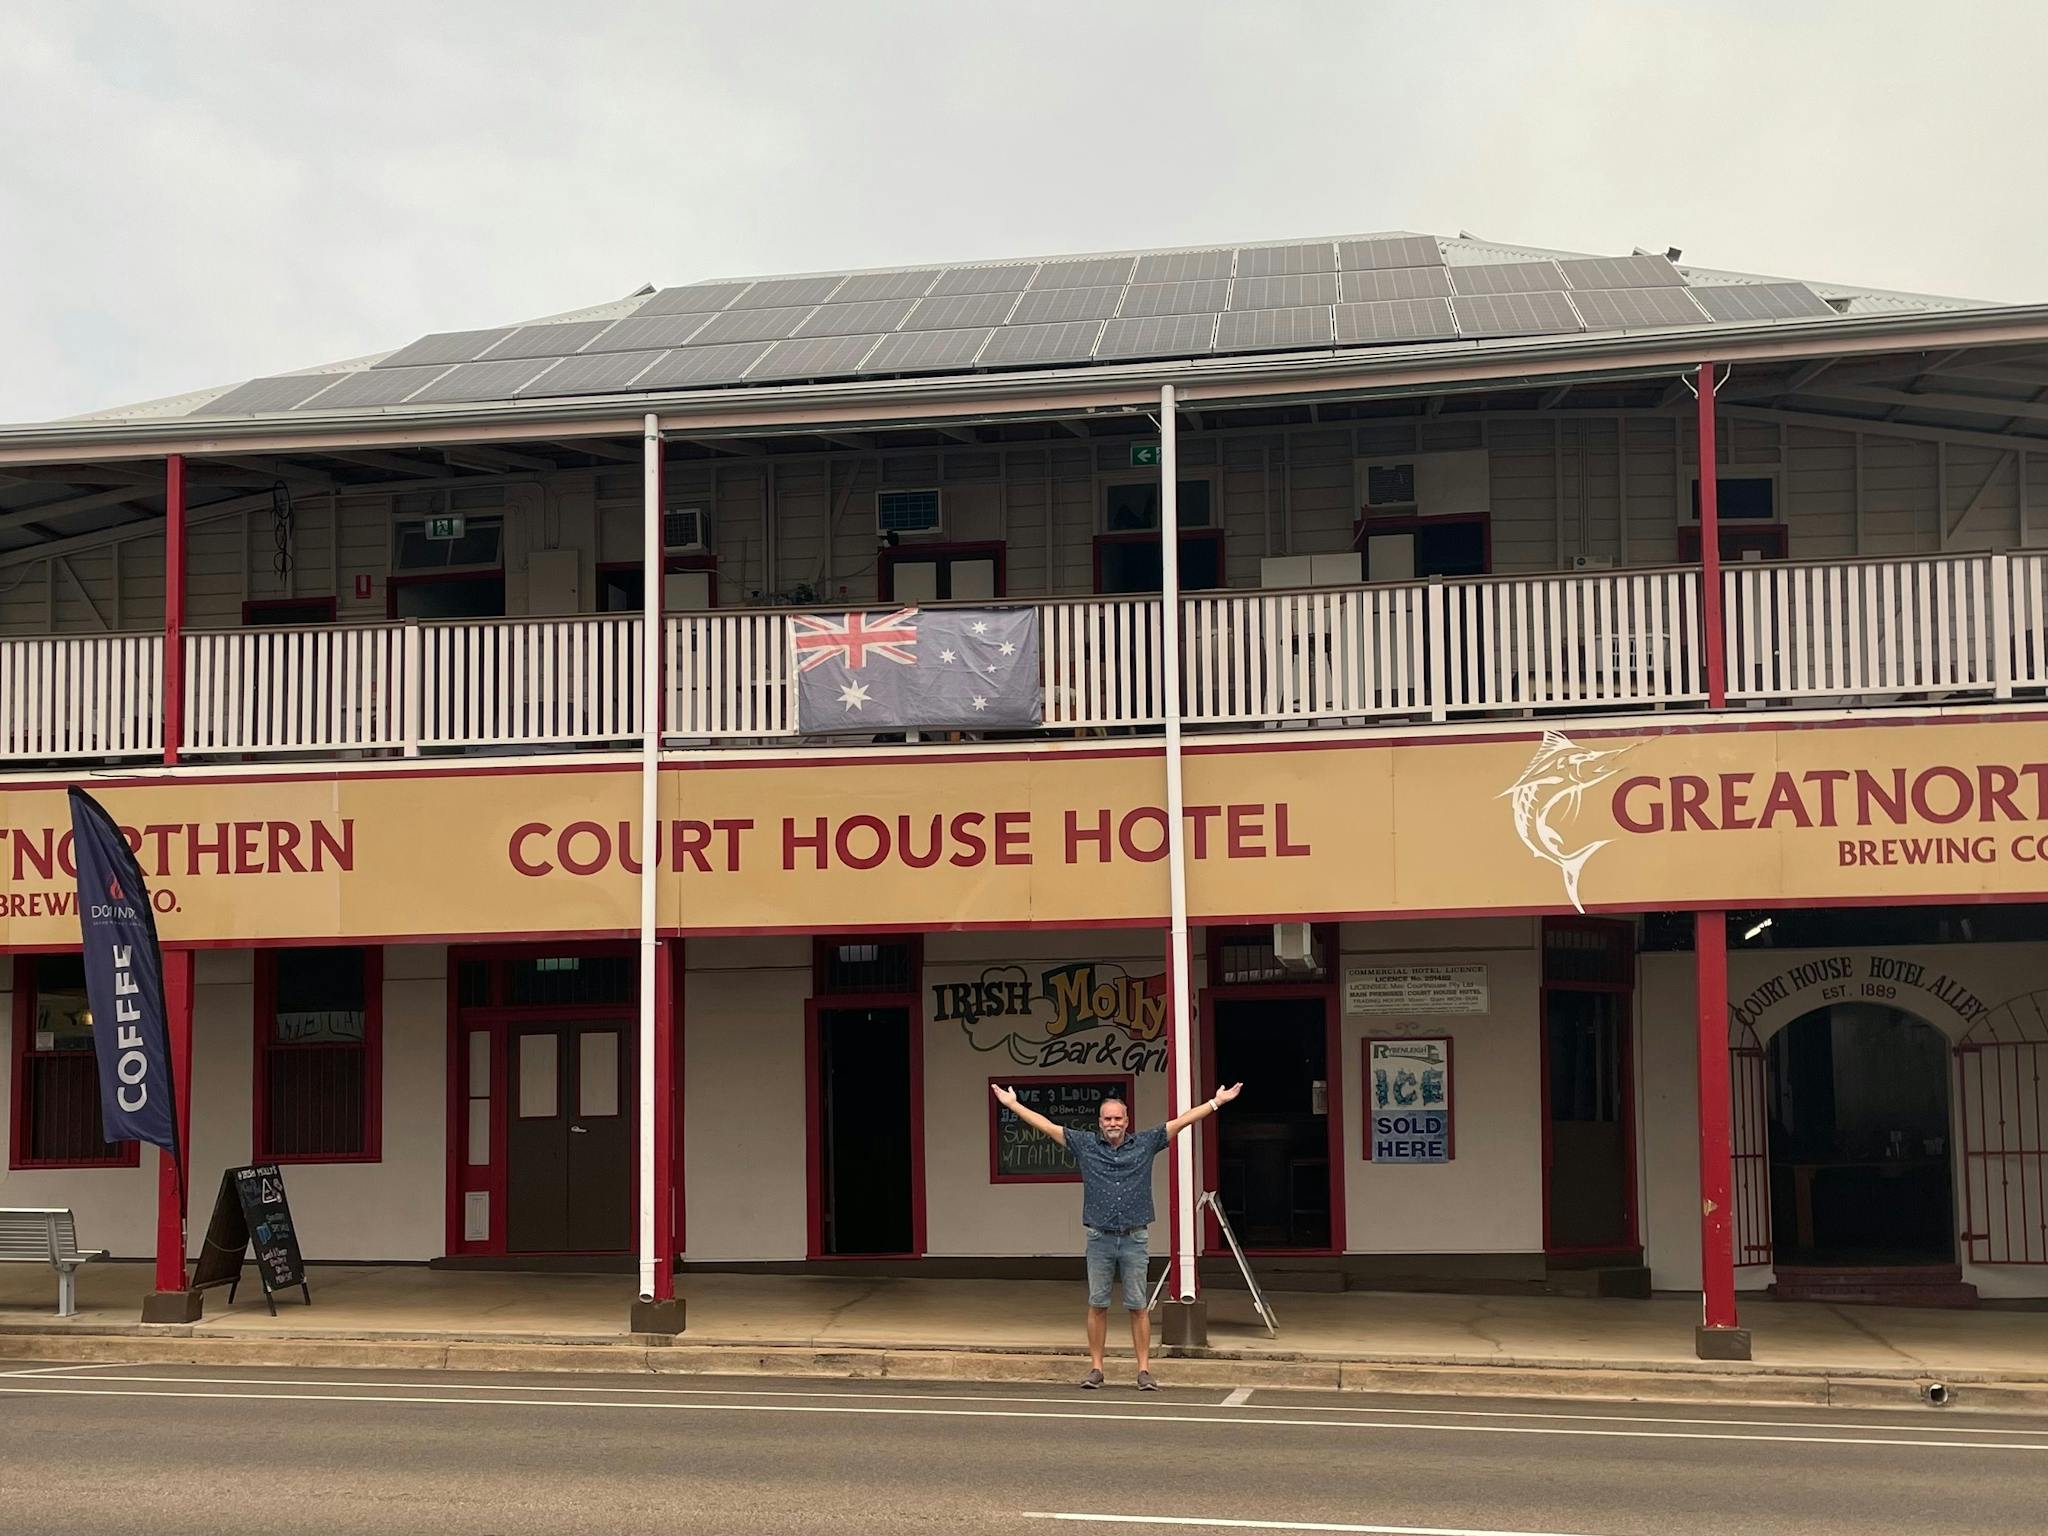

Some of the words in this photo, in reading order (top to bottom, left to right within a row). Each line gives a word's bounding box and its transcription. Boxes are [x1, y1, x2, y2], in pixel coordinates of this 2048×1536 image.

[508, 819, 754, 877] COURT
[782, 814, 1032, 869] HOUSE
[1065, 803, 1311, 864] HOTEL
[1839, 837, 1996, 867] BREWING
[932, 982, 1032, 1025] IRISH
[1735, 975, 1790, 1026] COURT
[1787, 956, 1853, 991] HOUSE
[1868, 956, 1925, 988] HOTEL
[1925, 975, 1989, 1023] ALLEY
[1822, 985, 1853, 1000] EST.
[1861, 983, 1897, 999] 1889
[112, 944, 148, 1113] COFFEE
[1039, 1040, 1099, 1068] Bar
[1096, 1033, 1121, 1066] &
[1374, 1067, 1444, 1109] ICE
[1377, 1117, 1441, 1135] SOLD
[1377, 1141, 1443, 1158] HERE
